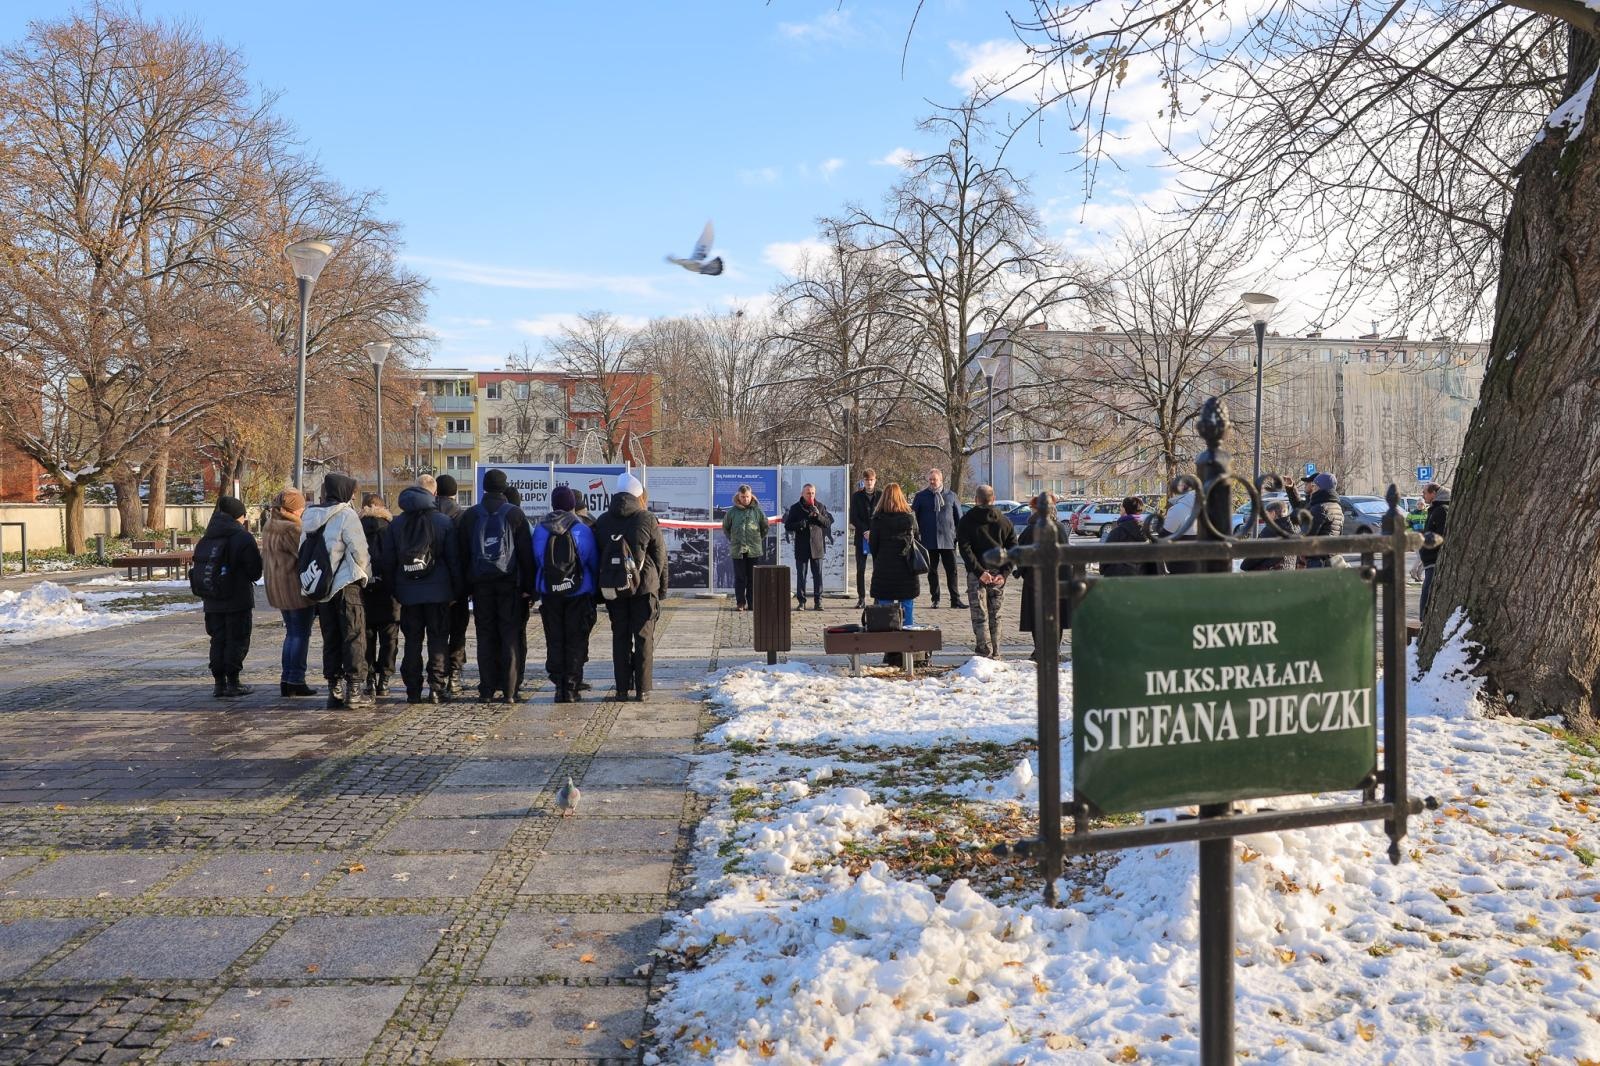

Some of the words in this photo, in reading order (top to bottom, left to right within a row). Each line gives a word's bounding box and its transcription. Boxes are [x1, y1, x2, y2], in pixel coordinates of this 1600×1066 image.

[1420, 468, 1428, 479] P
[508, 480, 548, 492] żdżajcie
[520, 492, 548, 502] ŁOPCY
[583, 493, 614, 511] ASTA
[403, 563, 424, 572] PUMA
[552, 581, 572, 592] PUMA
[1192, 620, 1279, 650] SKWER
[1145, 659, 1323, 696] IM.KS.PRAŁATA
[1083, 699, 1240, 753] STEFANA
[1247, 687, 1372, 739] PIECZKI
